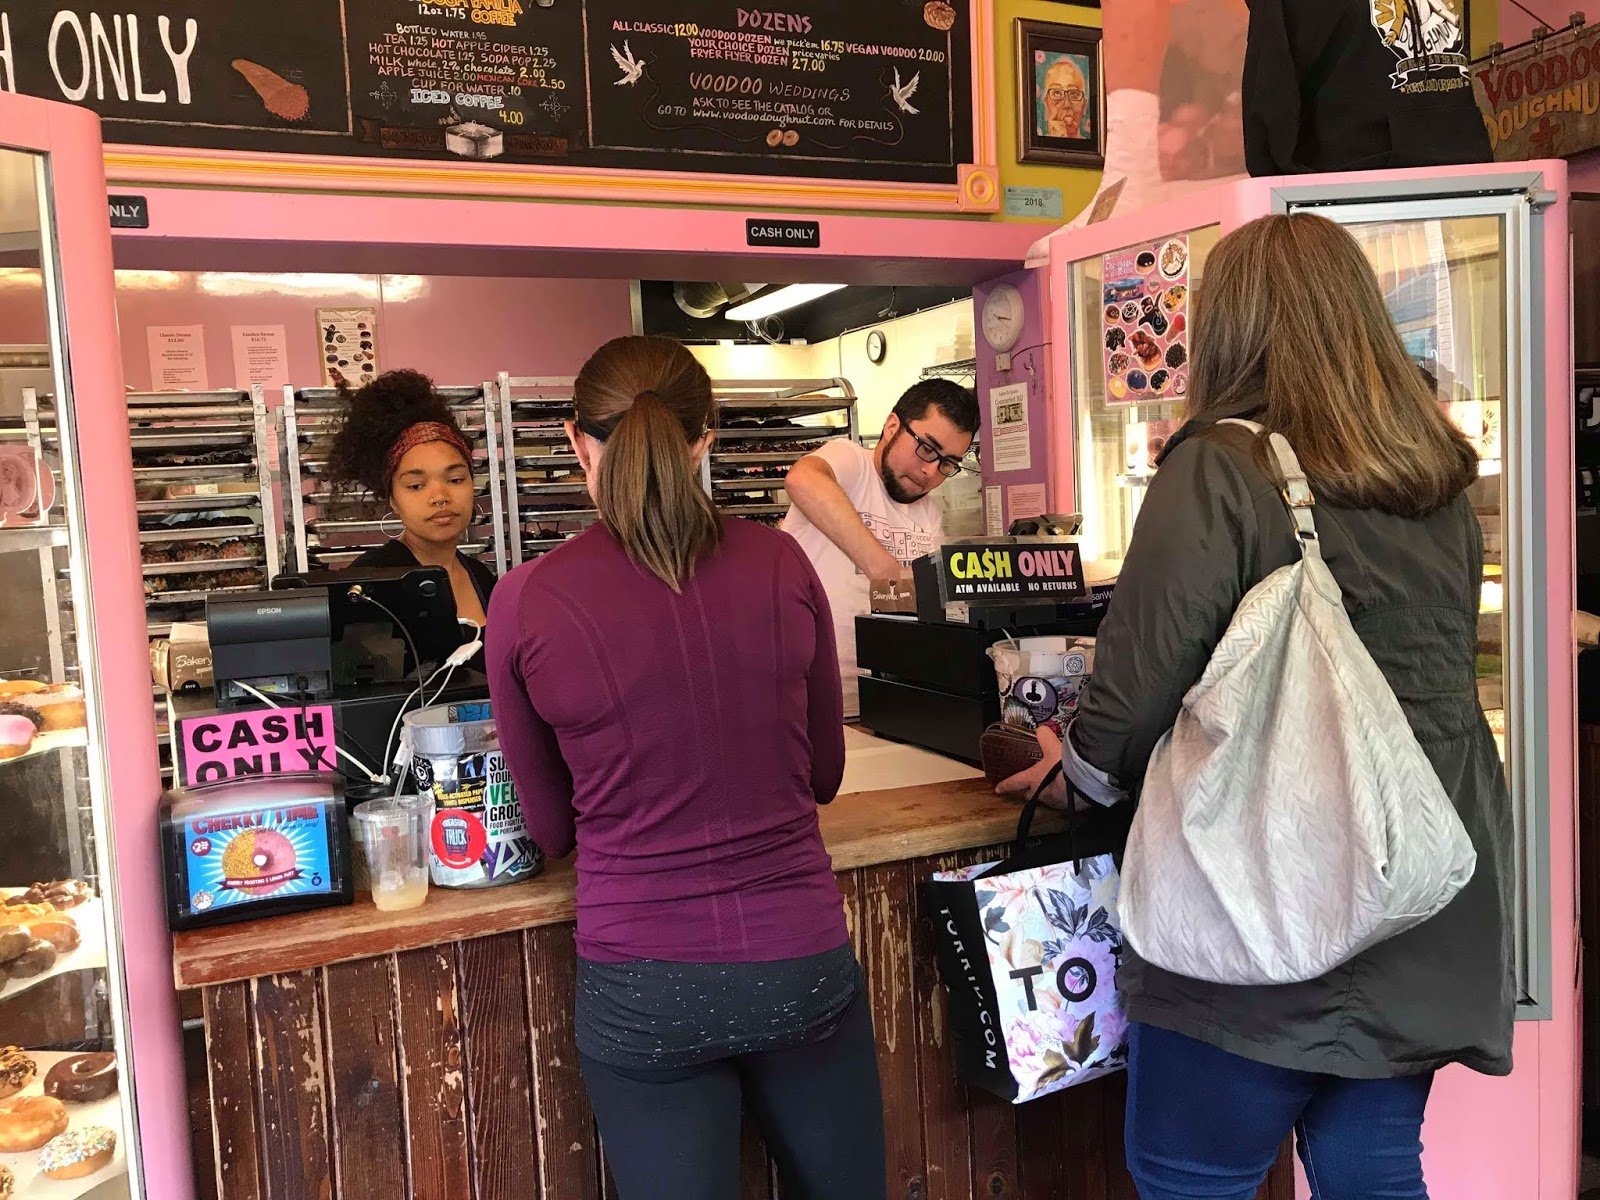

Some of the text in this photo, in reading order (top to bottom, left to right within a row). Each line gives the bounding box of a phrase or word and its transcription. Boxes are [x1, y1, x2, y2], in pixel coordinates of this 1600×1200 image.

[418, 4, 466, 19] 12oz 1.75
[471, 9, 516, 26] COFFEE
[737, 8, 812, 34] DOZENS
[396, 23, 487, 40] BOTTLED WATER 1.95
[613, 20, 632, 31] ALL
[633, 22, 675, 34] CLASSIC
[699, 28, 737, 41] VOODOO
[738, 33, 771, 44] DOZEN
[820, 40, 845, 53] 16.75
[846, 43, 879, 55] VEGAN
[881, 46, 917, 58] VOODOO
[919, 49, 945, 62] 20.00
[383, 33, 549, 57] TEA 1.25 HOT APPLE CIDER 1.25
[688, 38, 840, 61] YOUR CHOICE DOZEN price varies
[49, 10, 197, 104] ONLY
[369, 43, 557, 69] HOT CHOCOLATE 1.25 SODA POP 2.25
[690, 48, 826, 72] FRYER FLYER DOZEN 27.00
[369, 55, 404, 68] MILK
[464, 63, 516, 76] chocolate
[520, 66, 545, 79] 2.00
[378, 66, 565, 90] APPLE JUICE 2.00 MEXICAN COKE 2.50
[411, 78, 437, 90] CUP
[440, 81, 464, 92] FOR
[466, 83, 507, 98] WATER
[689, 72, 850, 101] VOODOO WEDDINGS
[410, 89, 504, 110] ICED COFFEE
[692, 97, 833, 117] ASK TO SEE THE CATALOG OR
[499, 110, 523, 125] 4.00
[657, 105, 894, 130] GO TO www.voodoodoughnut.com FOR DETAILS
[109, 204, 140, 218] NLY
[1024, 197, 1043, 207] 2018
[750, 226, 815, 240] CASH ONLY
[950, 548, 1074, 582] CA$H ONLY
[956, 582, 1077, 594] ATM AVAILABLE NO RETURNS
[257, 607, 282, 615] EPSON
[175, 654, 213, 668] Bakery
[192, 712, 324, 753] CASH
[490, 802, 524, 821] GROC
[445, 828, 467, 846] TRUCK
